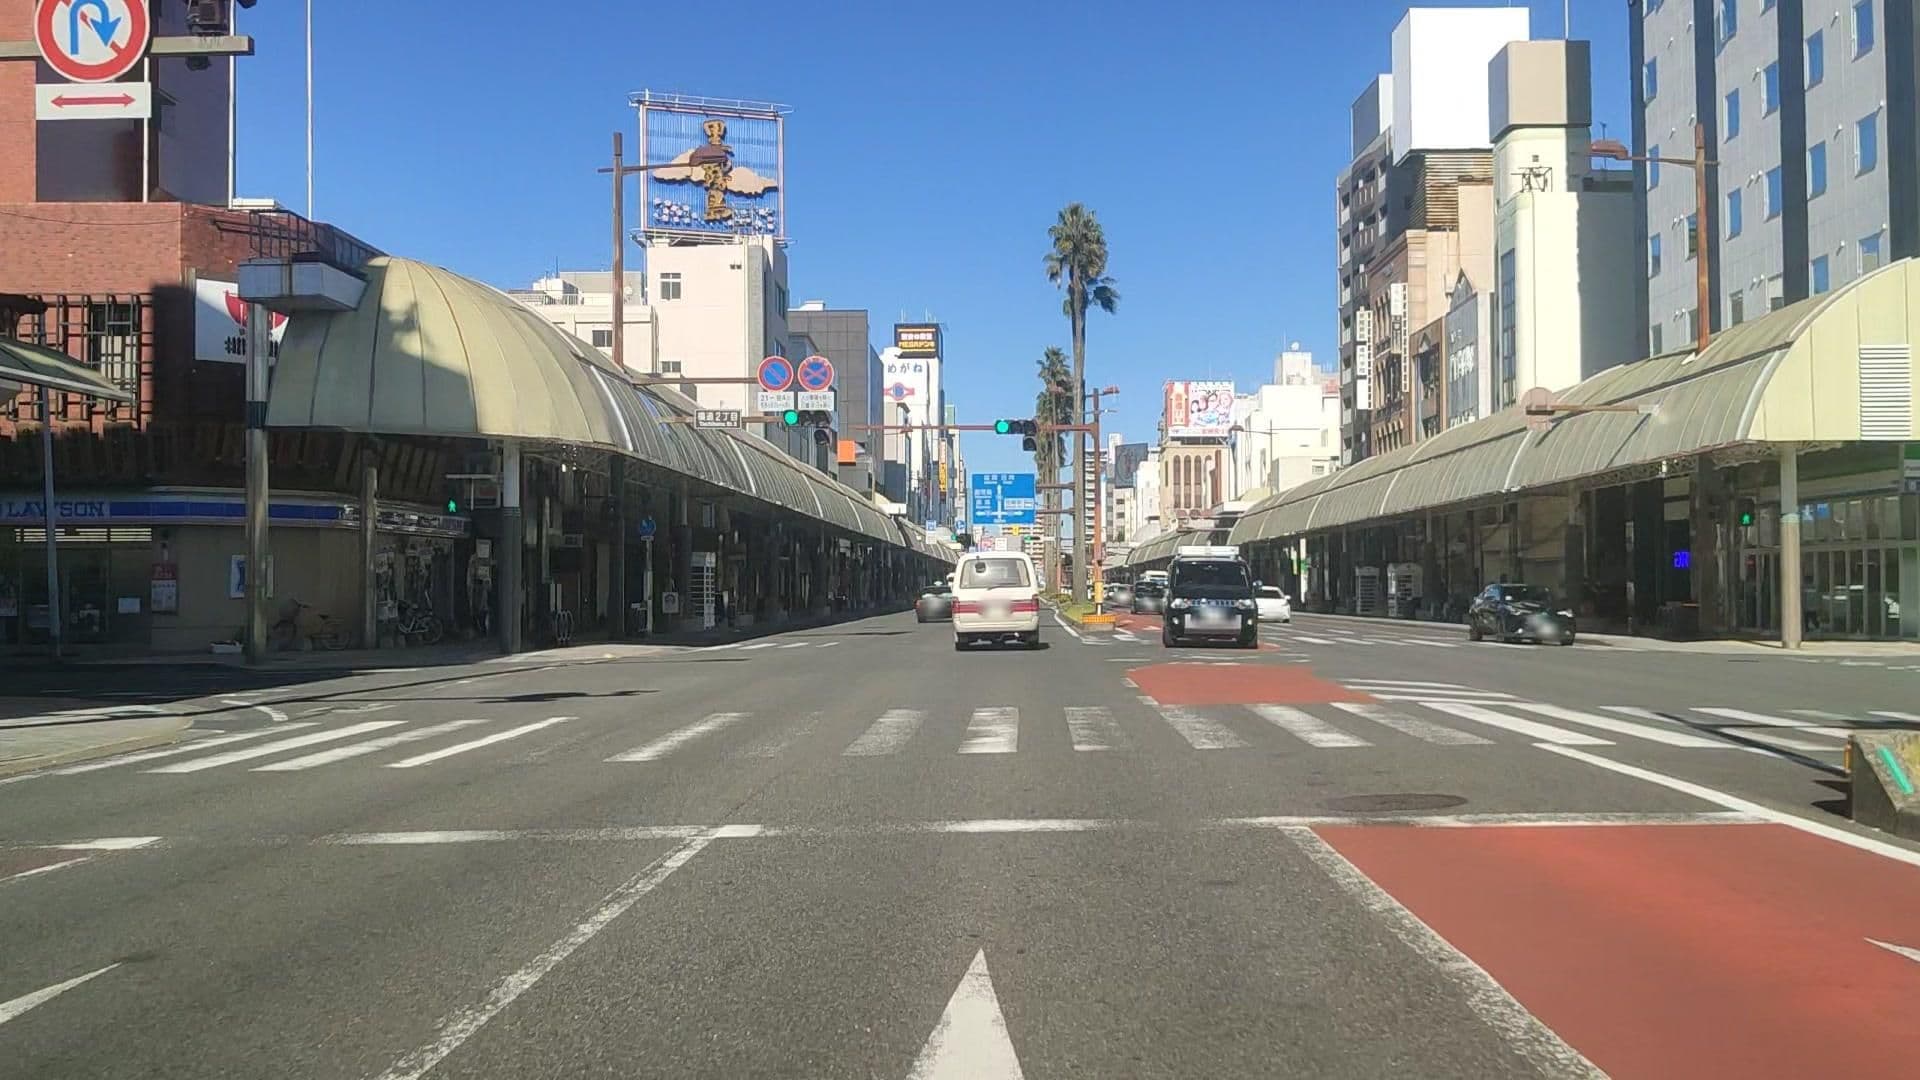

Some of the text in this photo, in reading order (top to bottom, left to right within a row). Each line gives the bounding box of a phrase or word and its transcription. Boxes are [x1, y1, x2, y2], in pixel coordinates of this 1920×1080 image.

[888, 363, 922, 373] めがね
[7, 501, 105, 517] LAWSON
